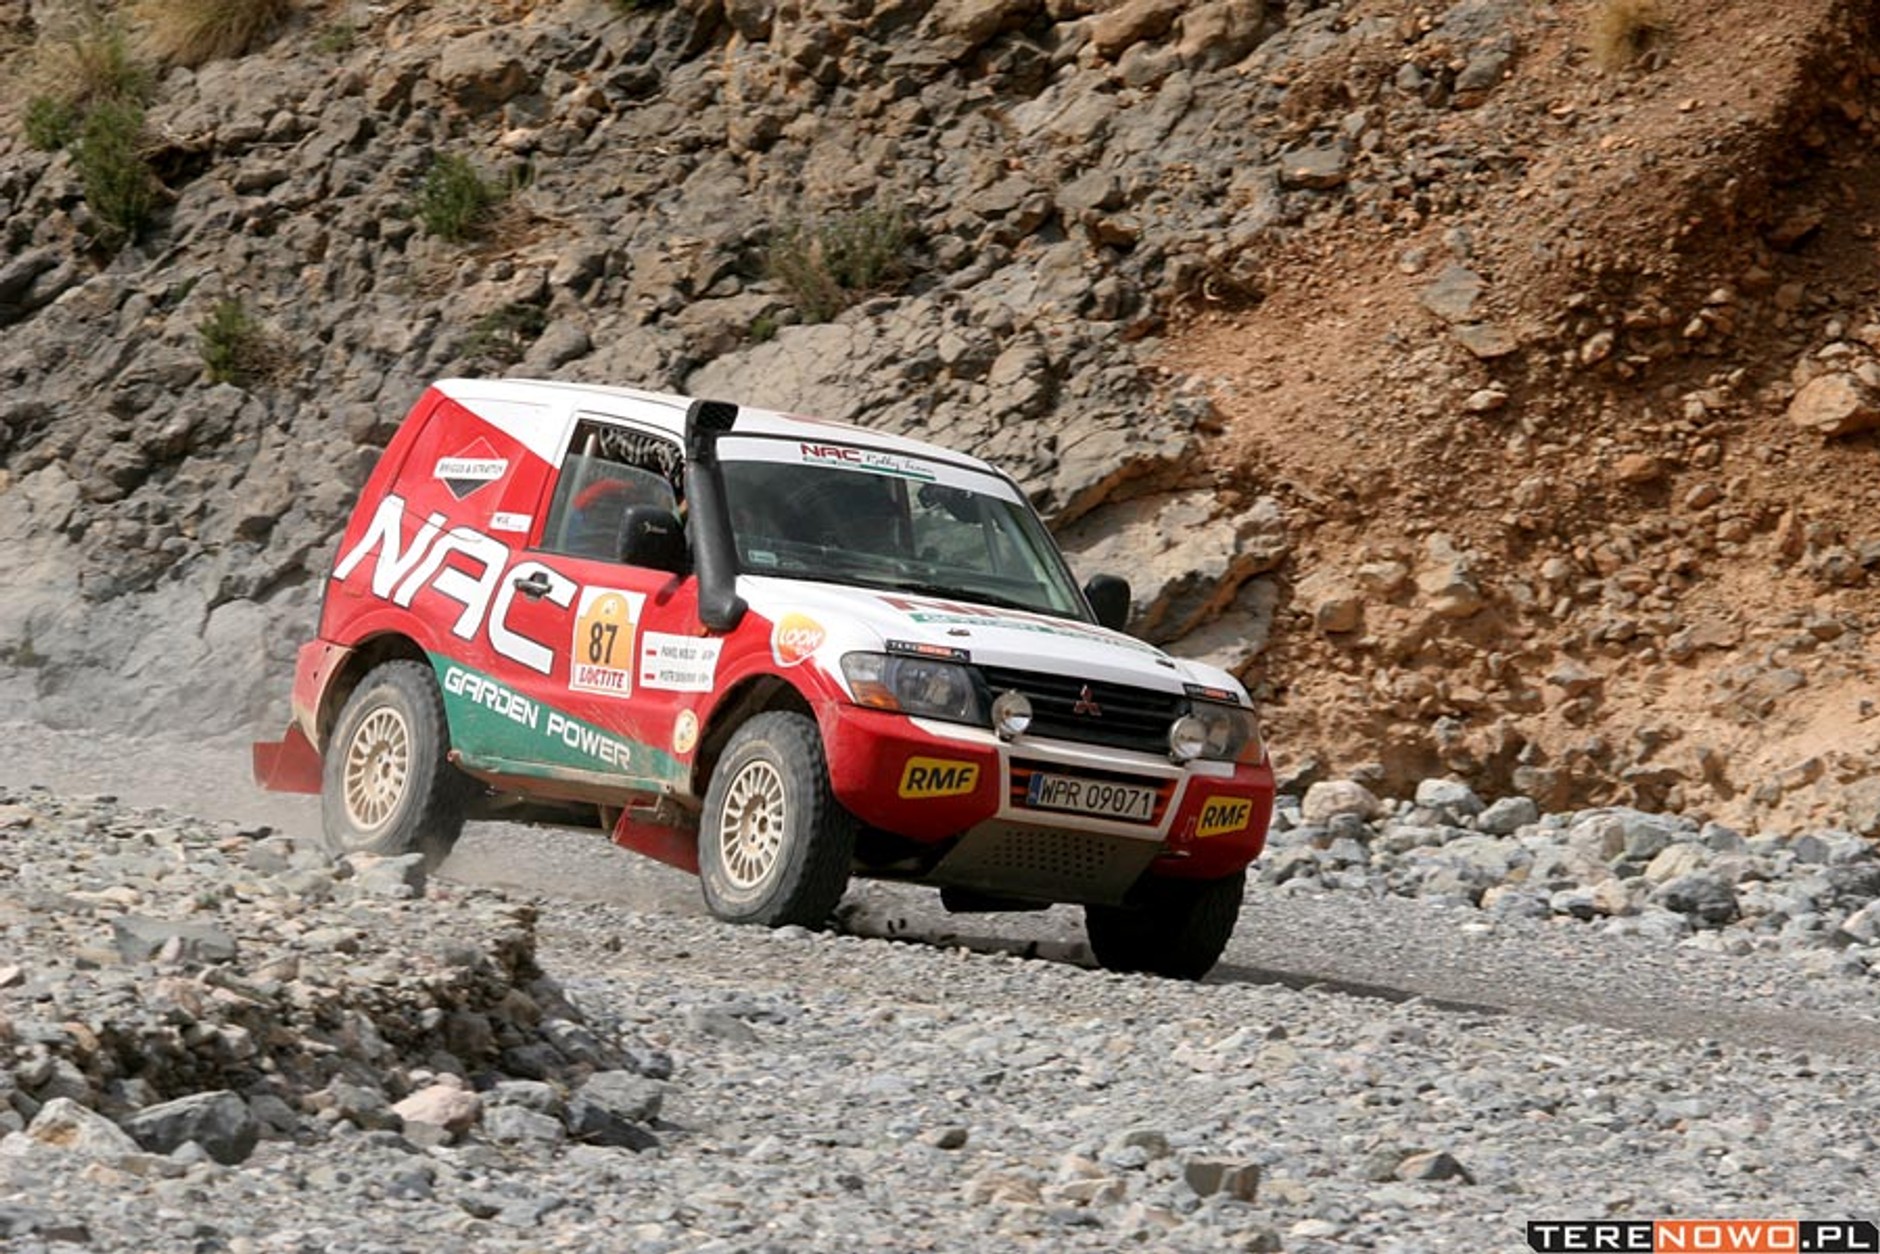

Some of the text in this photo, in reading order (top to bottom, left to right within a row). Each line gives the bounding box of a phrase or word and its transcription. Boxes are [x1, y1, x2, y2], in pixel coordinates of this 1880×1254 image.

[801, 443, 861, 463] NAC
[332, 494, 578, 675] NAC
[589, 622, 619, 664] 87
[579, 667, 625, 689] LOCTITE
[444, 666, 631, 770] GARDEN POWER
[906, 766, 974, 792] RMF
[1041, 778, 1151, 817] WPR 09071
[1201, 804, 1249, 829] RMF
